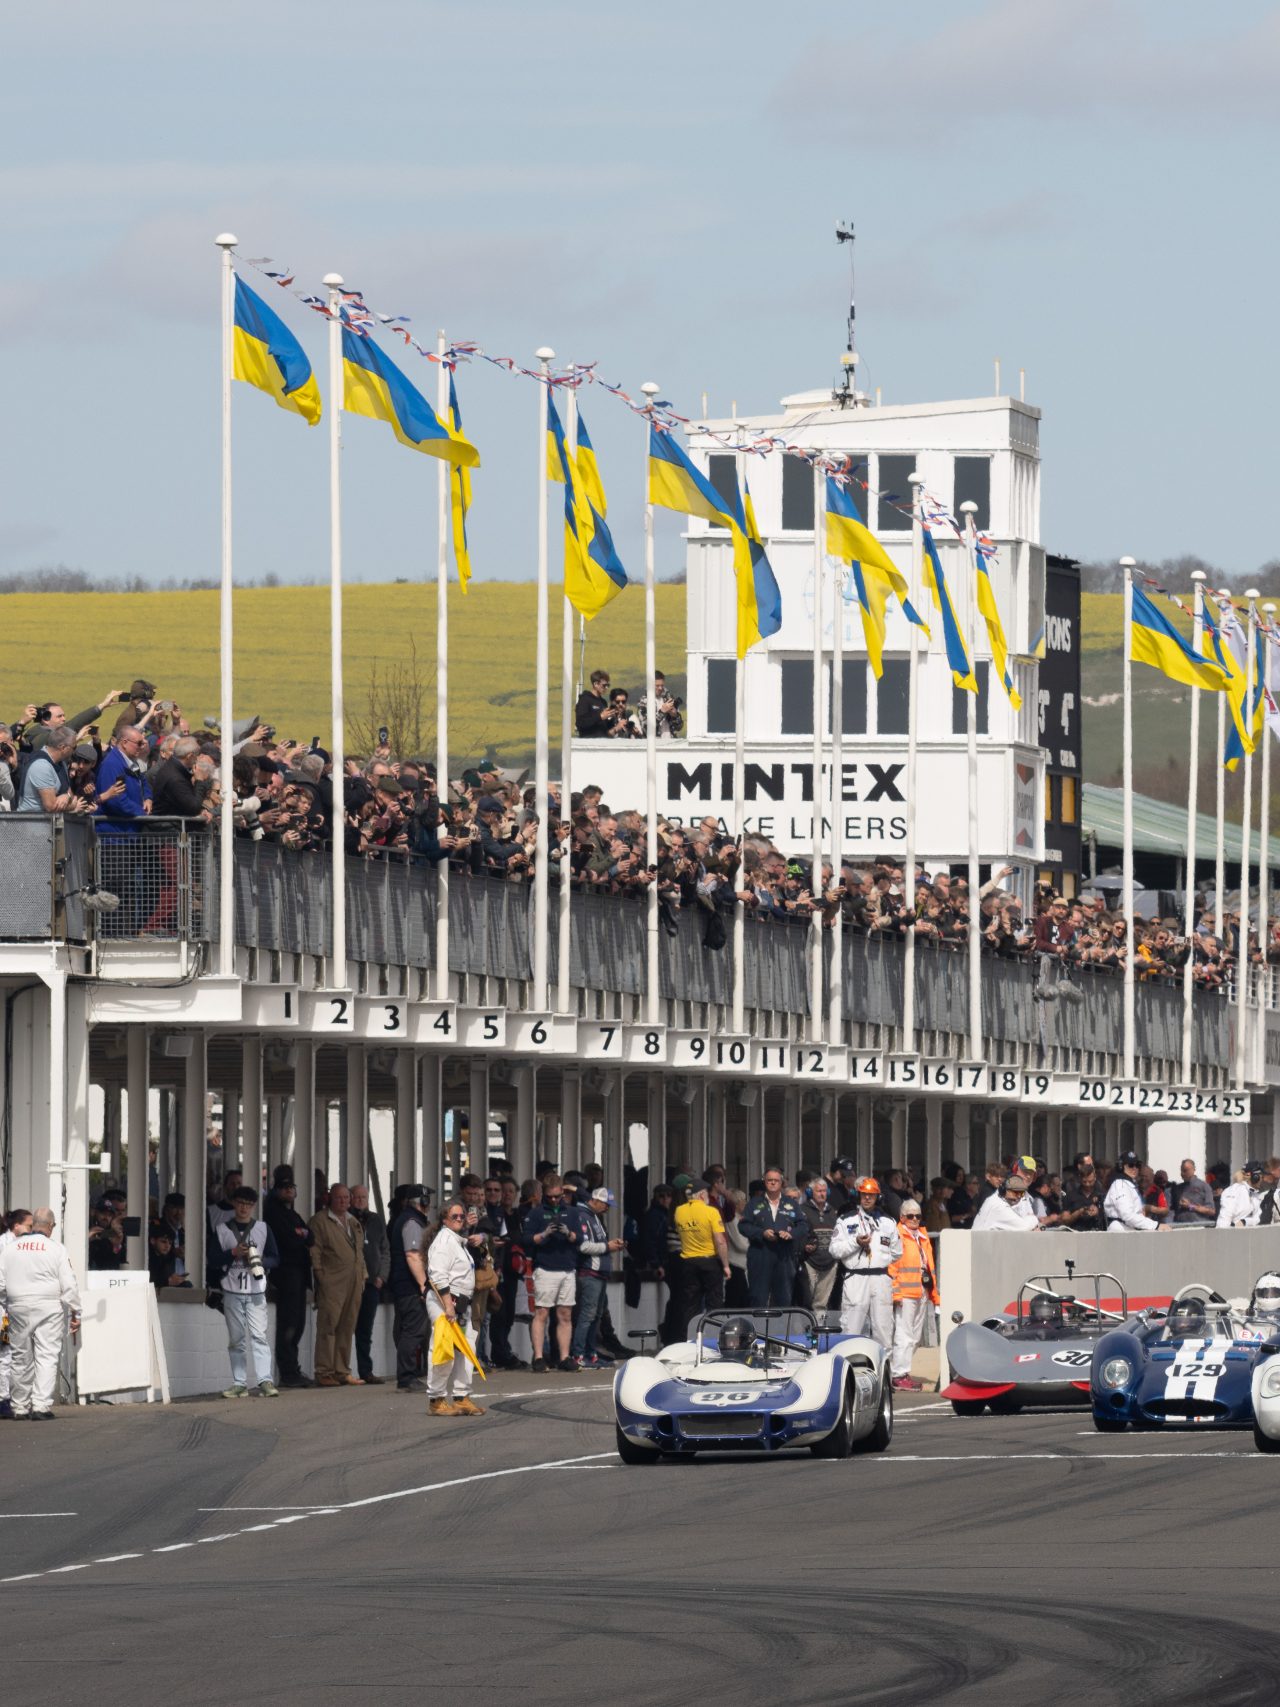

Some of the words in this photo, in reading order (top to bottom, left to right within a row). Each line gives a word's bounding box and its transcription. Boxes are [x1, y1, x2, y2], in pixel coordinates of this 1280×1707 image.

[667, 763, 907, 802] MINTEX
[791, 817, 907, 840] LINERS
[285, 992, 291, 1018] 1
[331, 999, 348, 1024] 2
[384, 1005, 400, 1030] 3
[434, 1010, 451, 1034] 4
[483, 1015, 498, 1040] 5
[531, 1020, 547, 1044] 6
[600, 1027, 615, 1050] 7
[645, 1032, 660, 1054] 8
[690, 1037, 705, 1059] 9
[717, 1042, 745, 1064] 10
[762, 1046, 784, 1068] 11
[797, 1050, 824, 1072] 12
[852, 1057, 878, 1078] 14
[890, 1060, 915, 1082] 15
[924, 1064, 949, 1085] 16
[957, 1067, 982, 1087] 17
[991, 1071, 1016, 1091] 18
[1024, 1075, 1049, 1095] 19
[1080, 1082, 1106, 1100] 20
[1112, 1086, 1135, 1105] 21
[1139, 1088, 1164, 1107] 22
[1167, 1092, 1192, 1110] 23
[1196, 1095, 1218, 1112] 24
[1223, 1098, 1245, 1116] 25
[16, 1241, 46, 1251] SHELL
[109, 1279, 129, 1288] PIT
[238, 1270, 248, 1290] 11
[1053, 1350, 1094, 1366] 30
[1172, 1364, 1223, 1377] 129
[701, 1392, 750, 1401] 96
